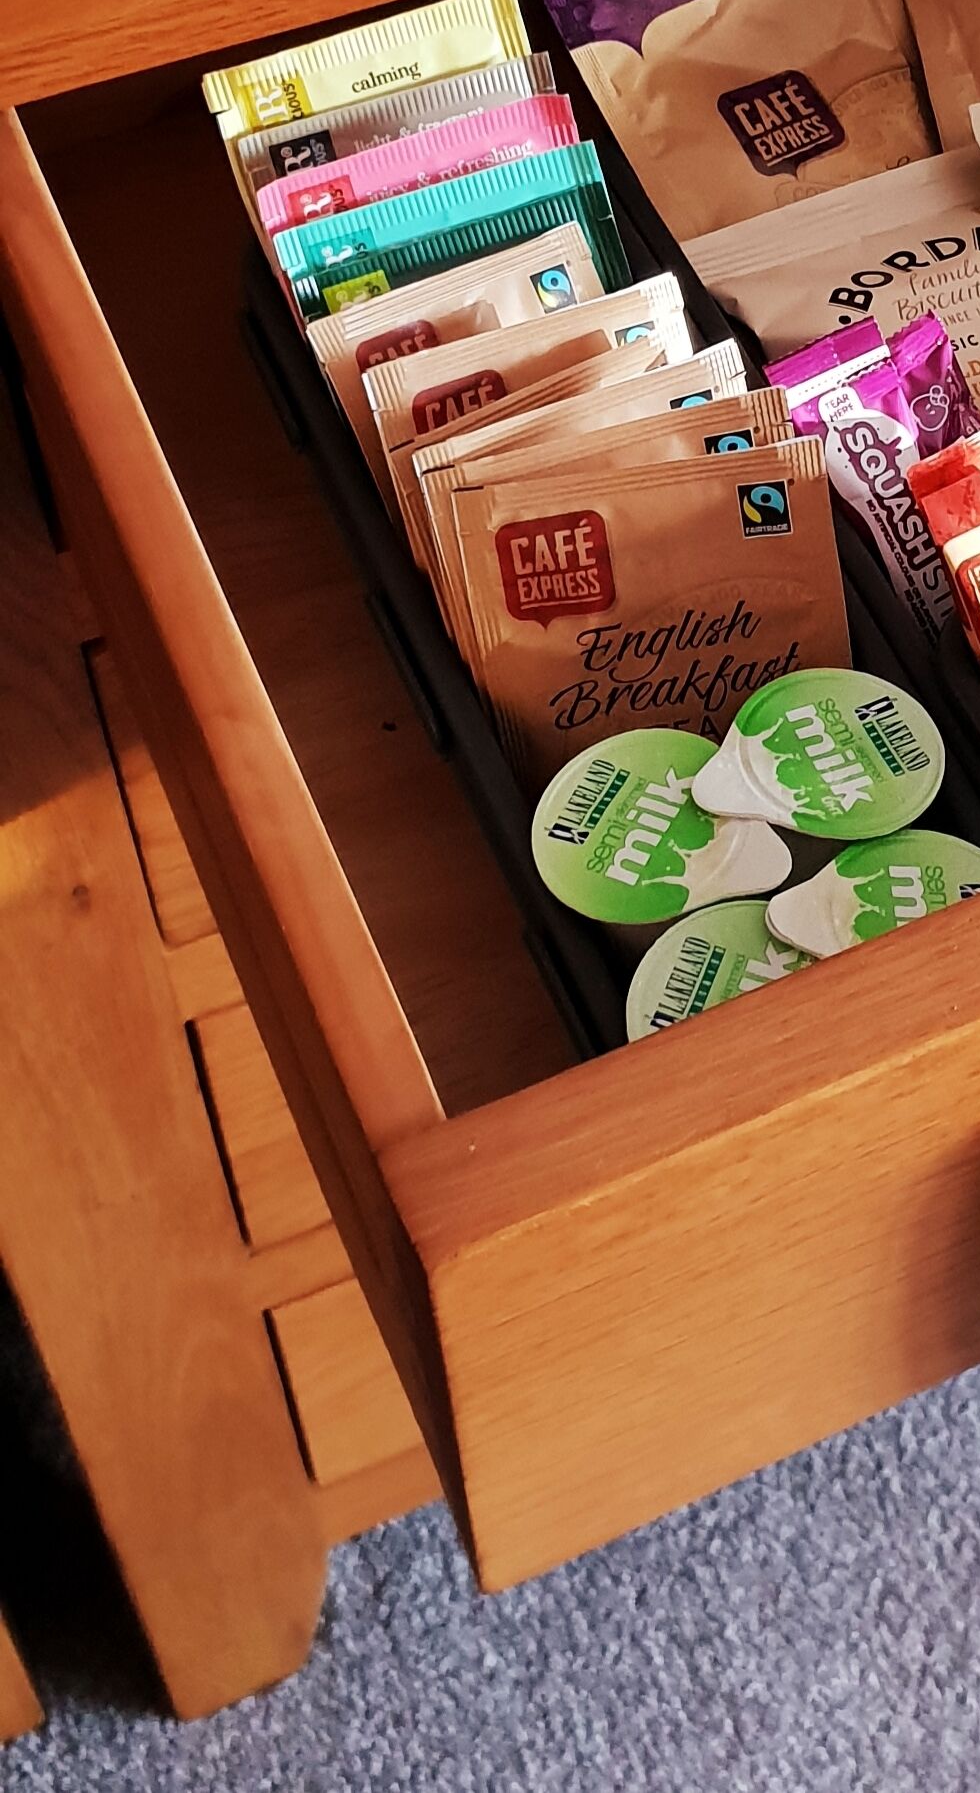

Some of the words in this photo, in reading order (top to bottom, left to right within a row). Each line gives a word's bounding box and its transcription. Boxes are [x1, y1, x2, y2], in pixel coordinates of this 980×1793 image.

[351, 62, 421, 94] calming
[734, 80, 808, 137] CAFÉ
[439, 139, 534, 181] refreshing
[754, 116, 830, 163] EXPRESS
[943, 310, 973, 327] INCE
[425, 377, 497, 432] CAFÉ
[510, 518, 596, 575] CAFÉ
[517, 567, 600, 603] EXPRESS
[576, 599, 762, 684] English
[550, 641, 800, 730] Breakfast
[818, 698, 862, 747] semi
[876, 710, 931, 772] LAKELAND
[785, 704, 874, 813] milk
[557, 759, 616, 826] LAKELAND
[586, 818, 628, 874] semi
[604, 765, 696, 887] milk
[666, 936, 711, 1014] LAKELAND
